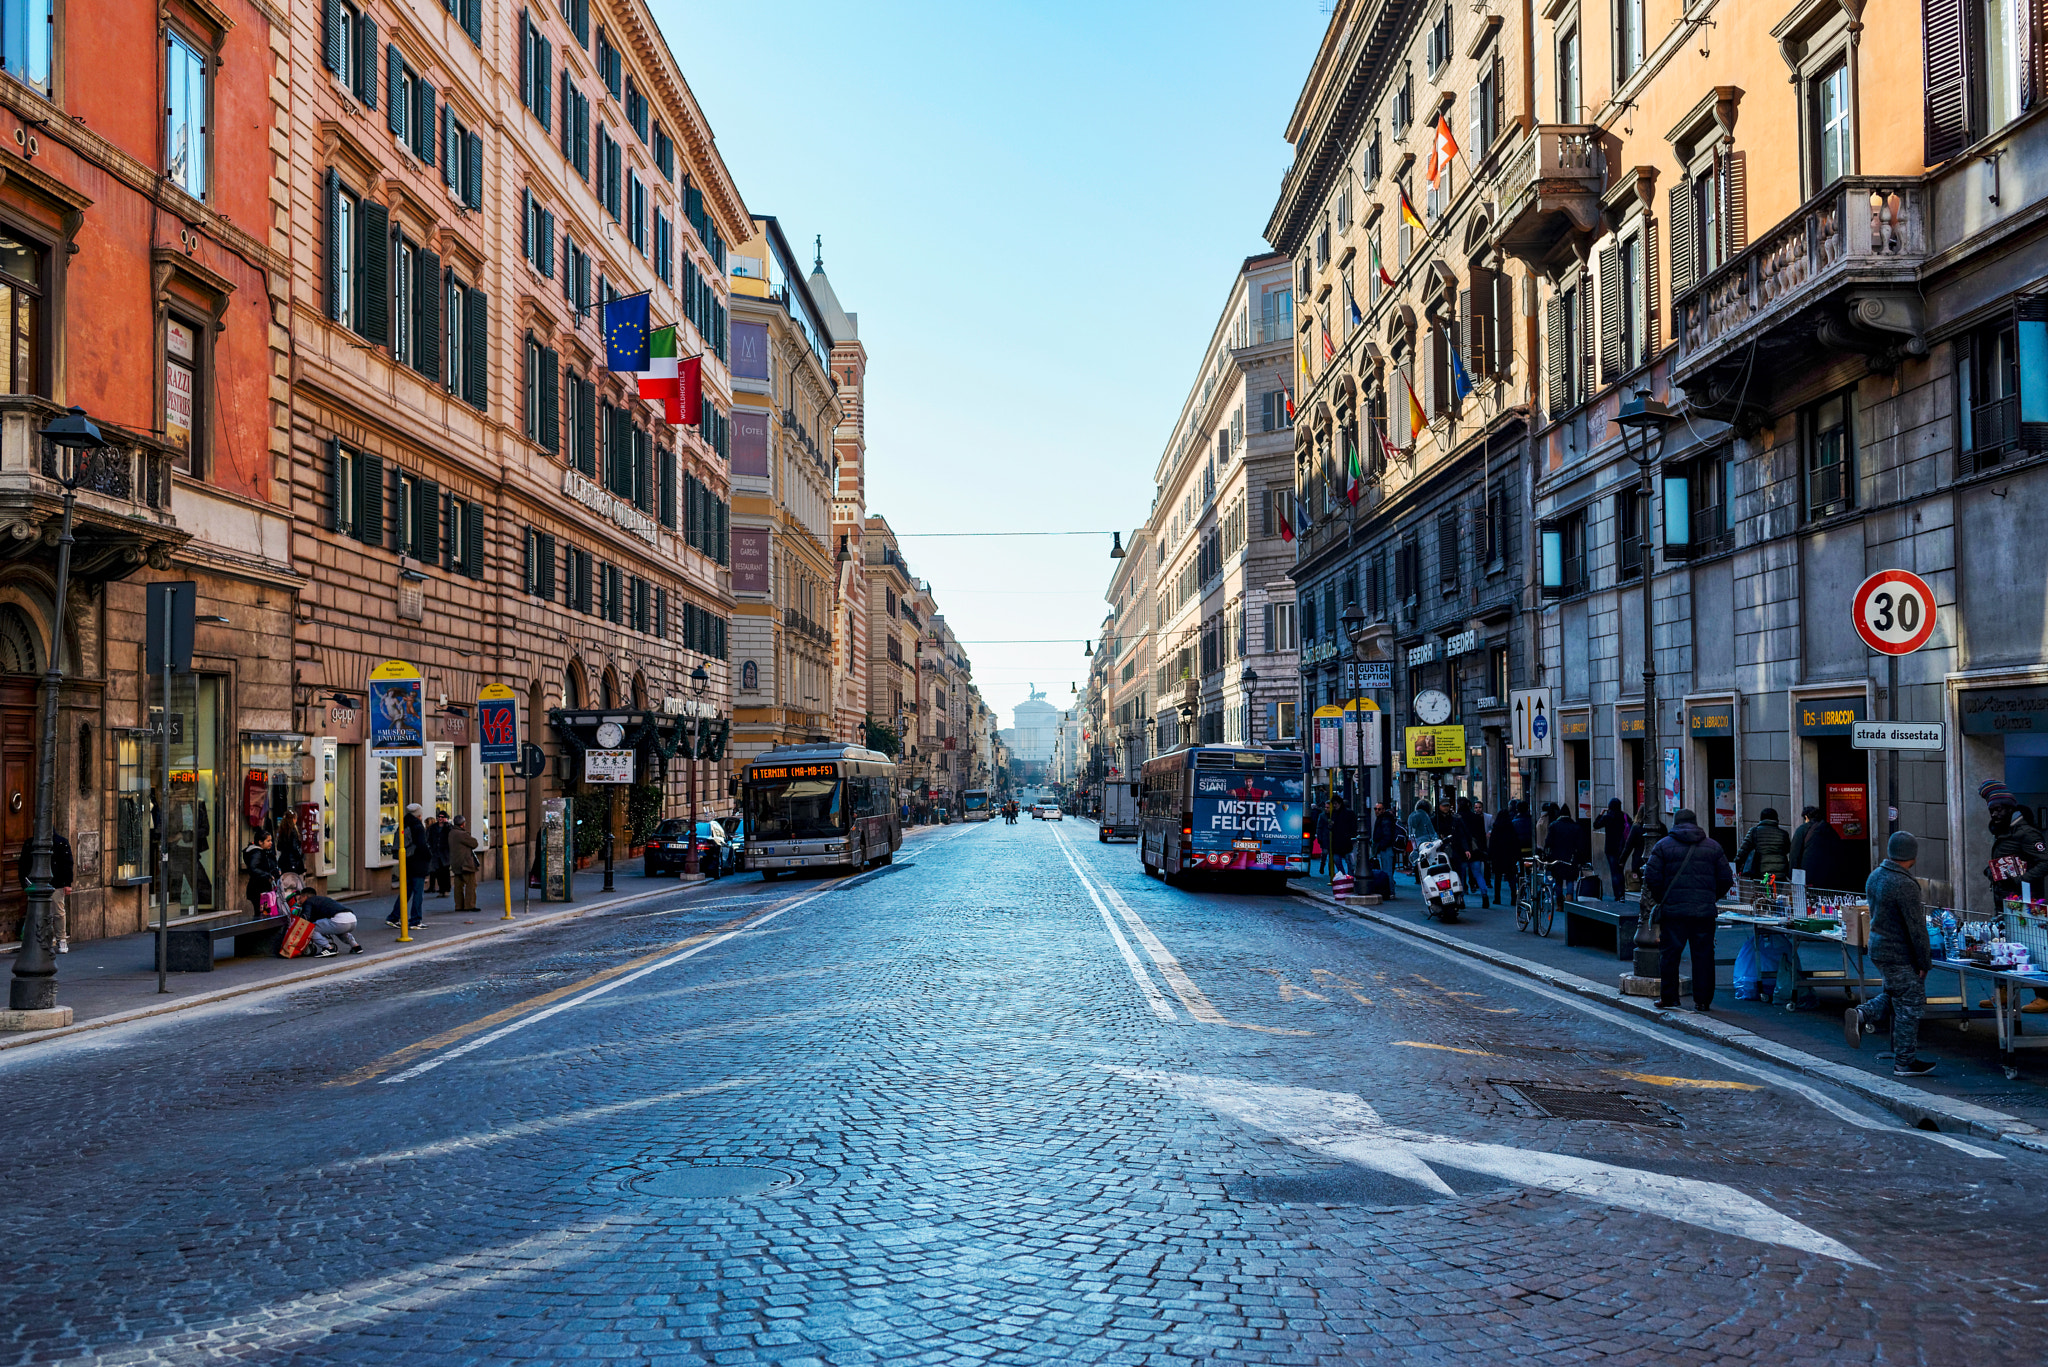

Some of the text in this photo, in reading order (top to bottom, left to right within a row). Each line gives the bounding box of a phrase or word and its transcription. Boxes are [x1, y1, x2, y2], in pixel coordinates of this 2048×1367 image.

[563, 469, 658, 545] ALBERGO QUIRINALE
[742, 538, 756, 547] ROOF
[740, 548, 760, 557] GARDEN
[735, 562, 763, 572] RESTAURANT
[745, 573, 755, 581] BAR
[1873, 592, 1920, 632] 30
[1447, 629, 1475, 657] ESEDRA
[1408, 643, 1433, 667] ESEDRA
[1348, 663, 1390, 673] AGUSTEA
[1348, 673, 1390, 681] RCEPTION
[663, 696, 687, 717] HOTEL
[332, 707, 356, 724] geppy
[1704, 715, 1728, 728] LIBRACCIO
[1803, 709, 1815, 726] ibs
[1820, 709, 1855, 725] LIBRACCIO
[377, 734, 417, 742] UNIVERSALE
[382, 728, 406, 736] MUSEO
[1857, 728, 1939, 740] strada dissestata
[752, 765, 833, 779] H TERMINI (MA-MB-FS)
